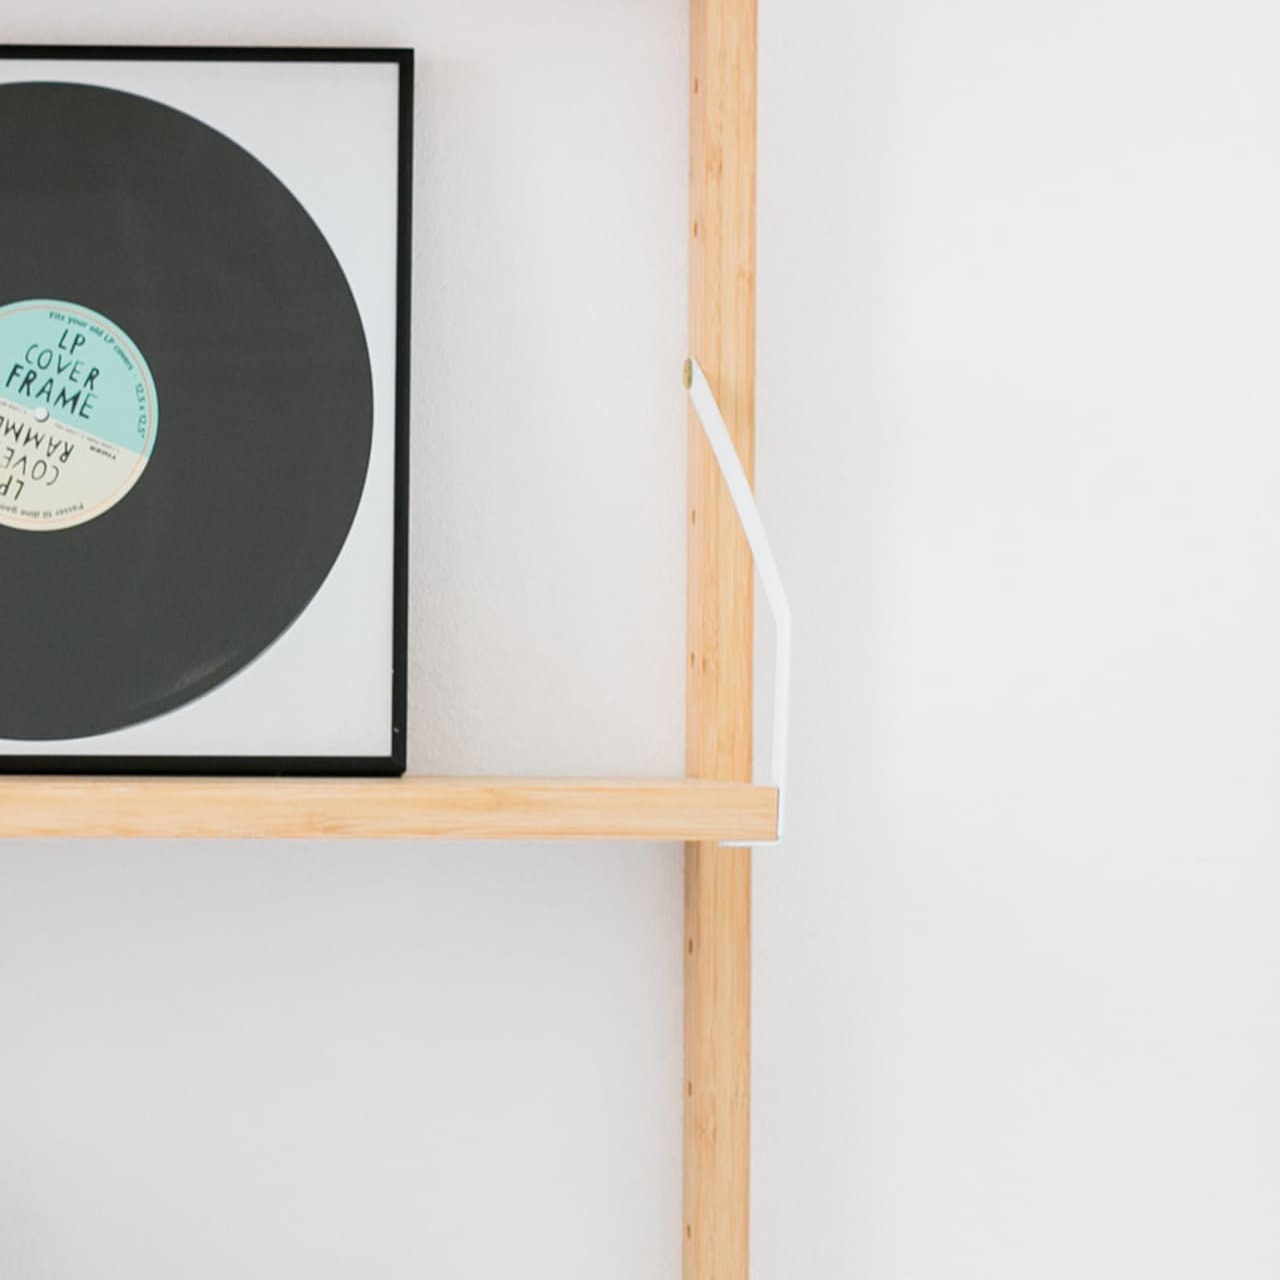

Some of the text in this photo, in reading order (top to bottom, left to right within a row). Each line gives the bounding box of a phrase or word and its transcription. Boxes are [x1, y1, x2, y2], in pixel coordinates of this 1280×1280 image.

[58, 328, 86, 355] LP
[24, 343, 100, 391] COVER
[5, 363, 99, 420] FRAME
